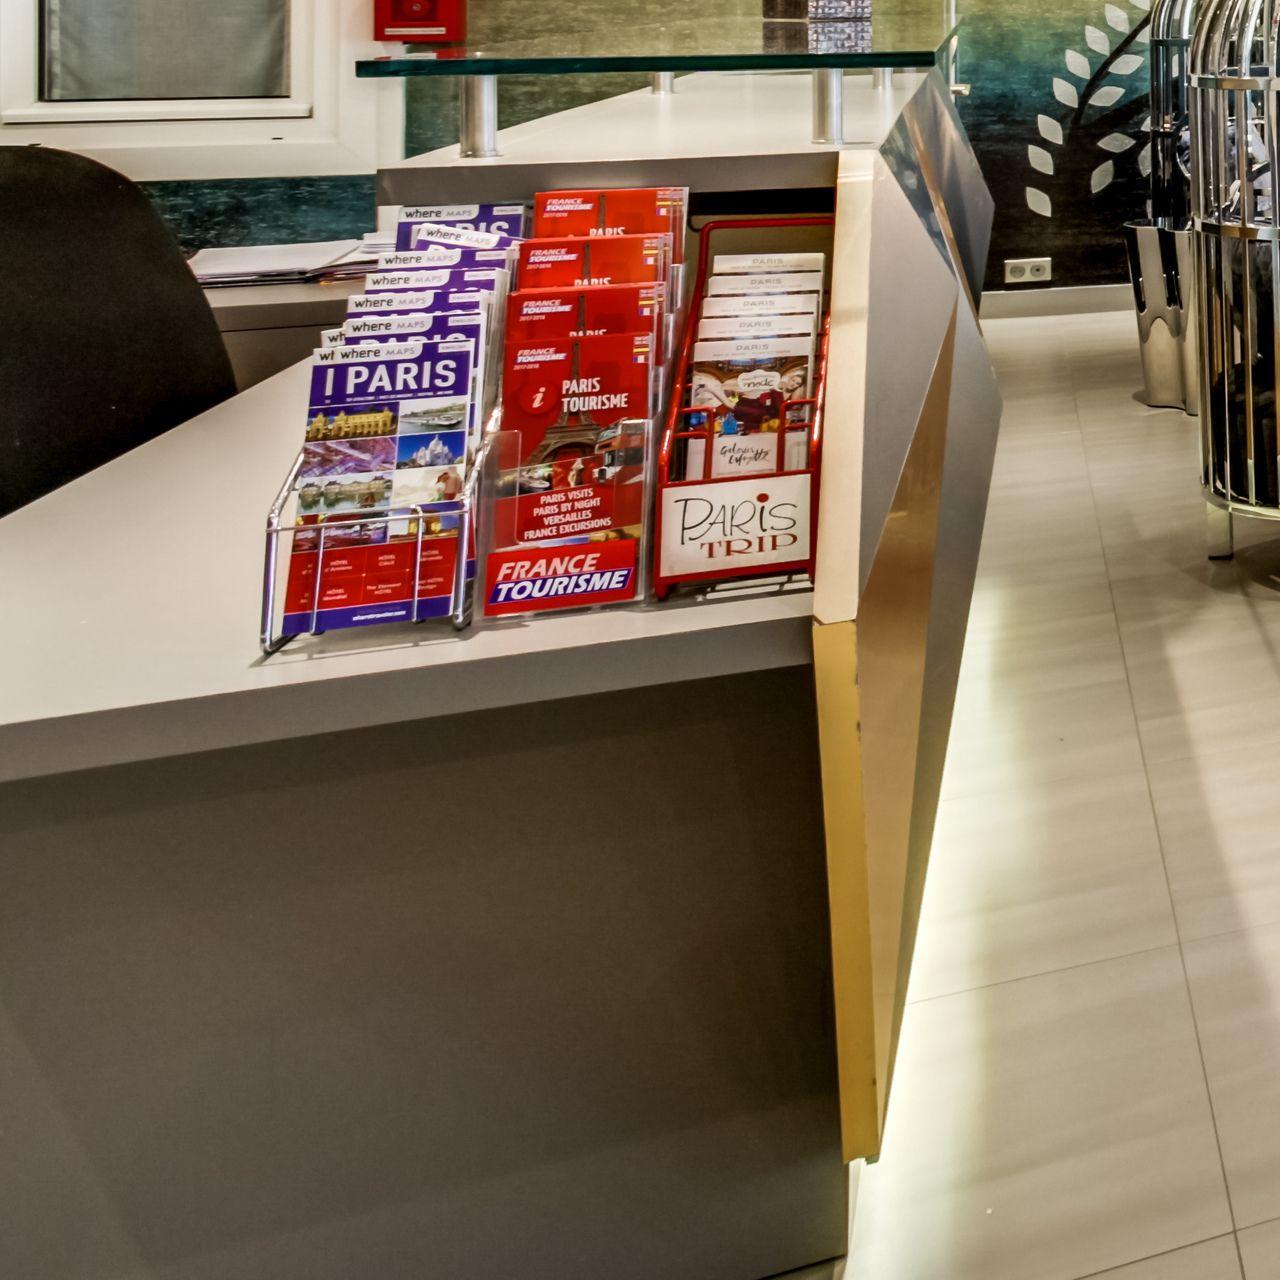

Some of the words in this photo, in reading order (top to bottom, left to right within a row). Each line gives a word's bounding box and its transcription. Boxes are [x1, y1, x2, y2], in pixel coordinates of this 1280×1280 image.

[405, 209, 442, 219] where
[426, 227, 461, 241] where
[384, 253, 422, 265] where
[371, 275, 410, 285] where
[354, 297, 394, 308] where
[352, 321, 392, 332] where
[340, 348, 381, 359] where
[385, 347, 416, 356] MAPS
[516, 352, 567, 364] TOURISME
[517, 347, 556, 356] FRANCE
[346, 359, 457, 395] PARIS
[562, 377, 601, 395] PARIS
[561, 392, 629, 413] TOURISME
[540, 493, 566, 505] PARIS
[567, 487, 594, 500] VISITS
[533, 505, 559, 517] PARIS
[560, 501, 573, 512] BY
[574, 497, 601, 510] NIGHT
[543, 509, 592, 526] VERSAILLES
[524, 527, 558, 540] FRANCE
[559, 517, 612, 534] EXCURSIONS
[699, 533, 798, 559] TRIP
[496, 553, 601, 582] FRANCE
[496, 570, 629, 602] TOURISME
